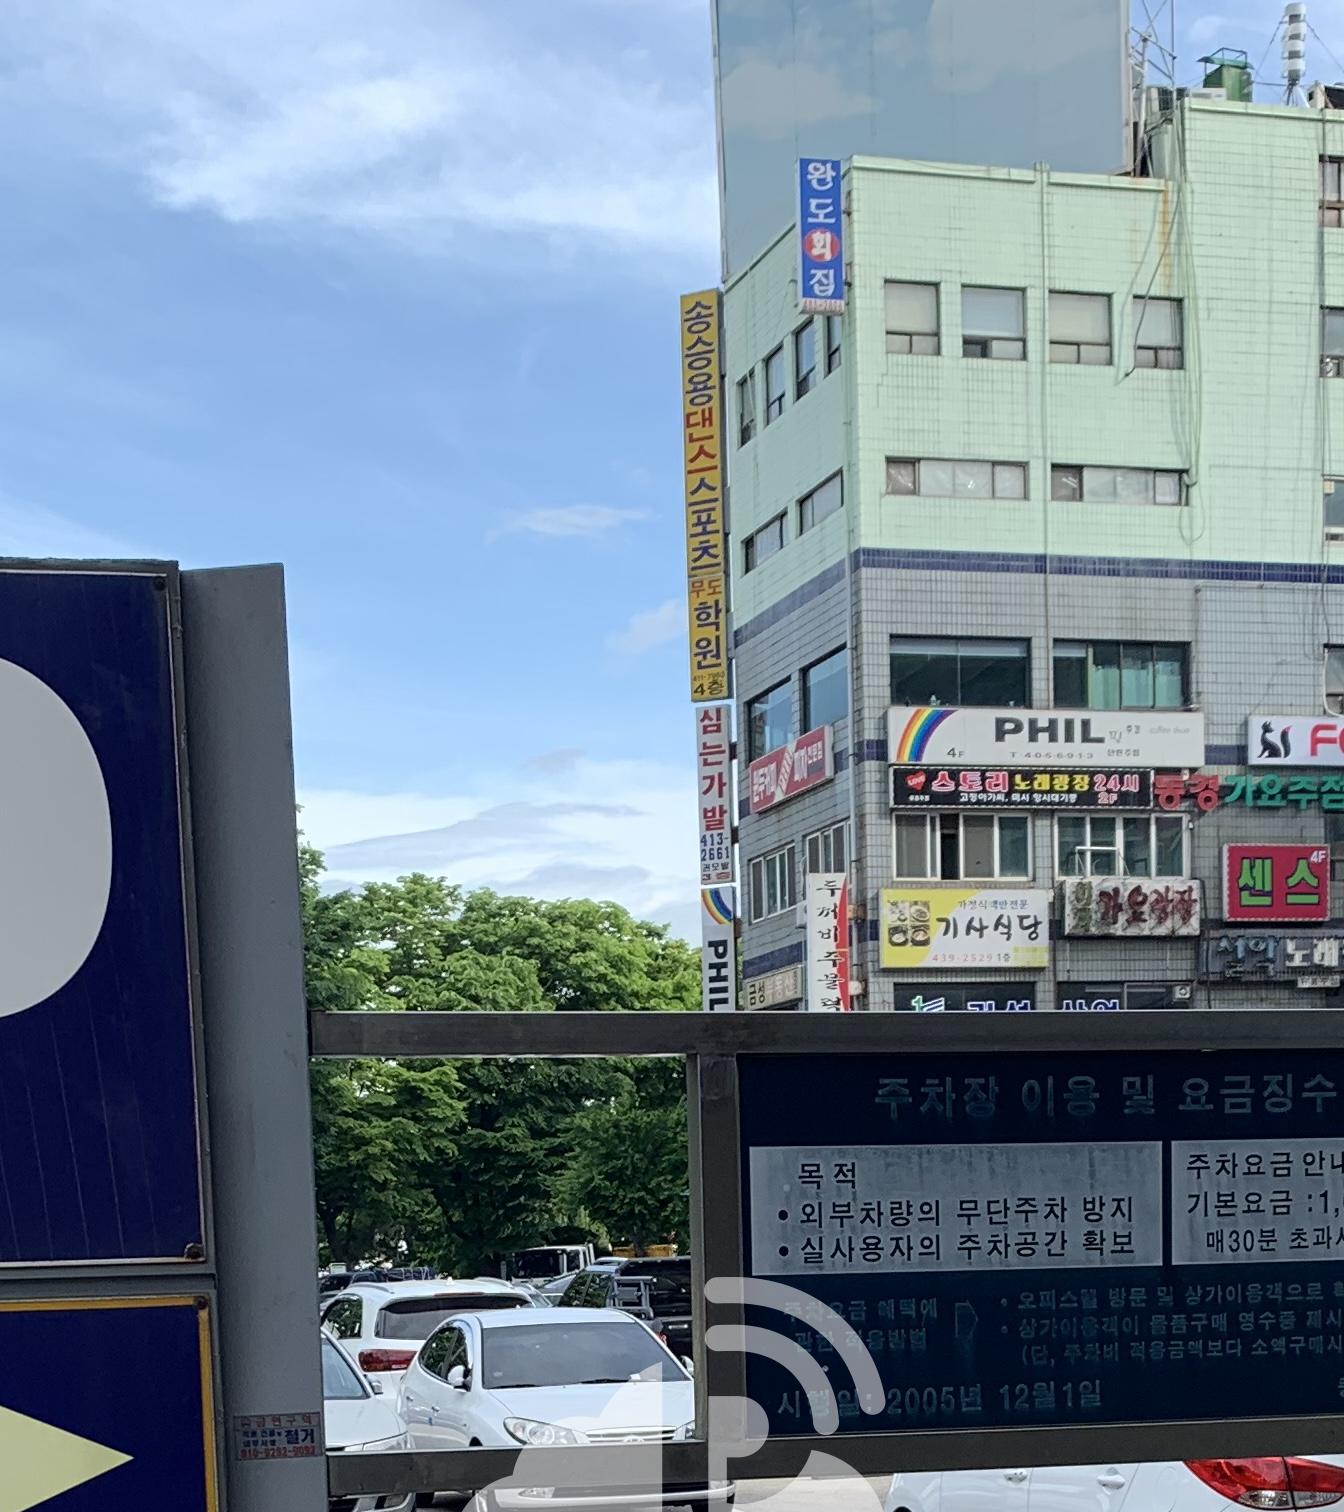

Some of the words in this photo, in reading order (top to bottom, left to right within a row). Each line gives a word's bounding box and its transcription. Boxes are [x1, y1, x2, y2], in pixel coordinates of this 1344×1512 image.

[805, 162, 837, 297] 완도회집
[694, 600, 722, 670] 학원
[694, 681, 723, 696] 4층
[994, 717, 1105, 744] PHIL
[931, 771, 1009, 792] 스토리
[1014, 773, 1090, 793] 노래광장
[1093, 773, 1140, 793] 24시
[1155, 773, 1220, 812] 동경
[1097, 792, 1118, 804] 2F
[701, 846, 730, 861] 2661
[1238, 857, 1321, 907] 센스
[1310, 849, 1326, 864] 4F
[936, 915, 1044, 941] 기사식당
[708, 939, 729, 1011] PHIL
[749, 979, 765, 1006] 금성
[875, 1075, 999, 1119] 주차장
[1021, 1074, 1099, 1117] 이용
[1122, 1075, 1154, 1114] 및
[1178, 1073, 1338, 1115] 요금징수
[798, 1161, 857, 1189] 목적
[1187, 1152, 1294, 1180] 주차요금
[800, 1199, 942, 1229] 외부차량의
[956, 1195, 1068, 1227] 무단주차
[1082, 1195, 1134, 1224] 방지
[1187, 1189, 1294, 1218] 기본요금
[801, 1233, 942, 1264] 실사용자의
[957, 1229, 1068, 1261] 주차공간
[1082, 1228, 1135, 1257] 확보
[1206, 1226, 1278, 1253] 매30분
[1017, 1289, 1098, 1311] 오피스텔
[1109, 1287, 1149, 1309] 방문
[1157, 1287, 1175, 1308] 및
[1185, 1282, 1324, 1306] 상가이용객으로
[1018, 1315, 1140, 1339] 상가이용객이
[1150, 1312, 1228, 1336] 물품구매
[1238, 1310, 1296, 1333] 영수증
[1130, 1337, 1242, 1362] 적용금액보다
[887, 1383, 983, 1416] 2005년
